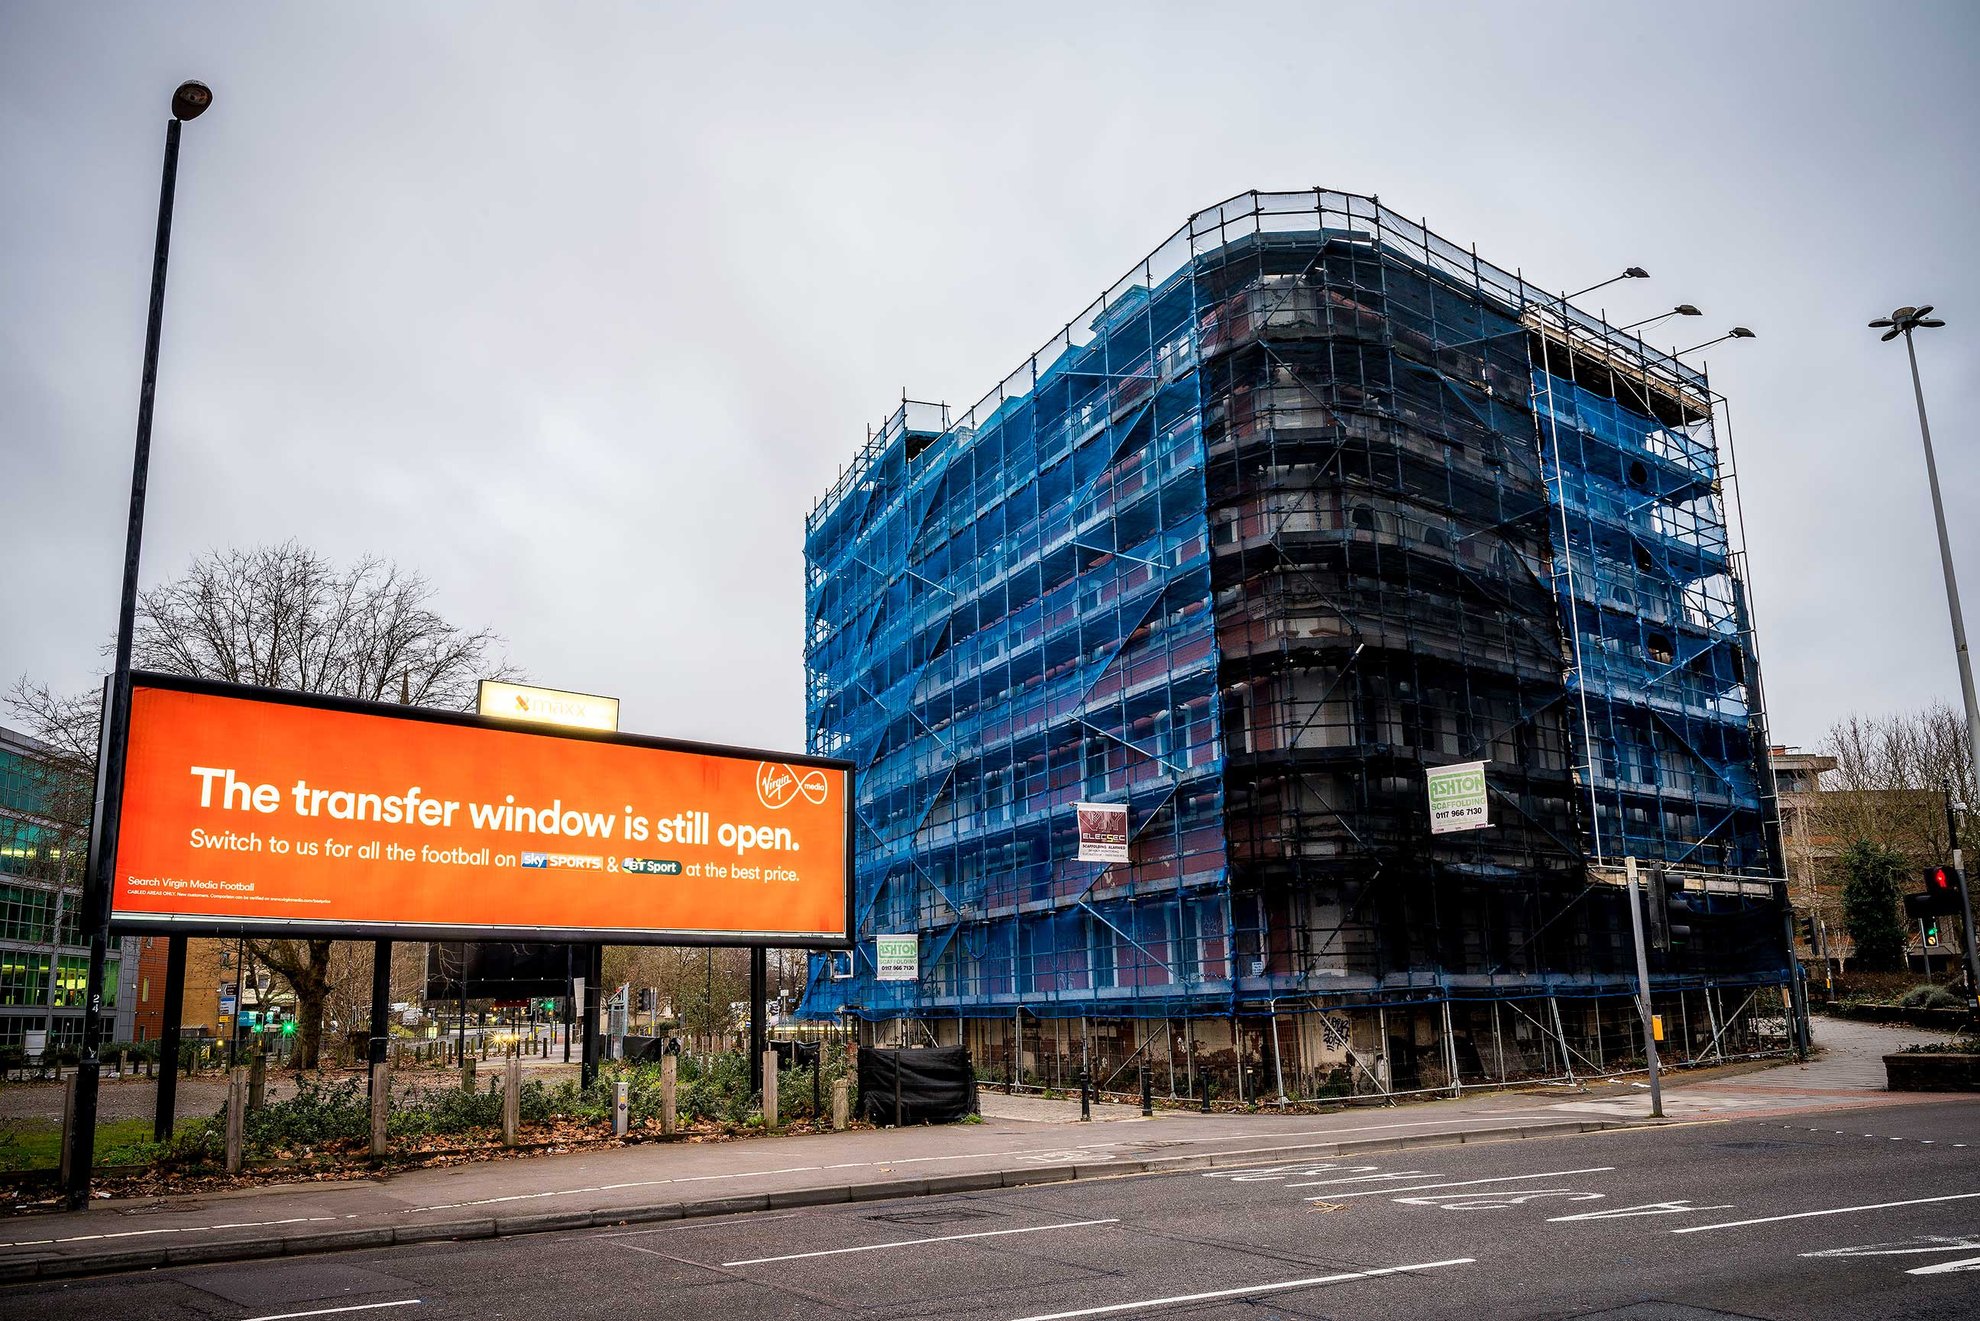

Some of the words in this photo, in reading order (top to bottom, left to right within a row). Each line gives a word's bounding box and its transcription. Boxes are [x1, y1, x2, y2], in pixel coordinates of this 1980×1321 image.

[762, 767, 793, 800] Virgin
[804, 782, 826, 791] media
[1430, 776, 1484, 796] ASHTON
[191, 766, 281, 813] The
[291, 780, 460, 827] transfer
[469, 795, 616, 838] window
[624, 805, 649, 842] is
[656, 811, 710, 846] still
[717, 822, 800, 855] open.
[1432, 798, 1486, 811] SCAFFOLDING
[1435, 811, 1450, 819] 0117
[1451, 809, 1465, 818] 966
[1466, 807, 1483, 816] 7130
[1082, 833, 1126, 842] ELECSEC
[189, 828, 262, 852] Switch
[268, 836, 290, 854] to
[296, 841, 319, 856] us
[324, 838, 353, 858] for
[358, 841, 380, 861] all
[386, 843, 416, 863] the
[421, 845, 490, 868] football
[494, 853, 516, 868] on
[523, 853, 546, 868] sky
[549, 855, 601, 870] SPORTS
[606, 856, 620, 873] &
[629, 861, 646, 872] BT
[646, 861, 677, 874] Sport
[685, 863, 702, 878] at
[705, 863, 728, 879] the
[731, 864, 761, 881] best
[764, 866, 800, 884] price.
[127, 875, 160, 887] Search
[161, 877, 188, 889] Virgin
[189, 880, 218, 889] Media
[219, 881, 255, 892] Football
[878, 944, 917, 955] ASHTON
